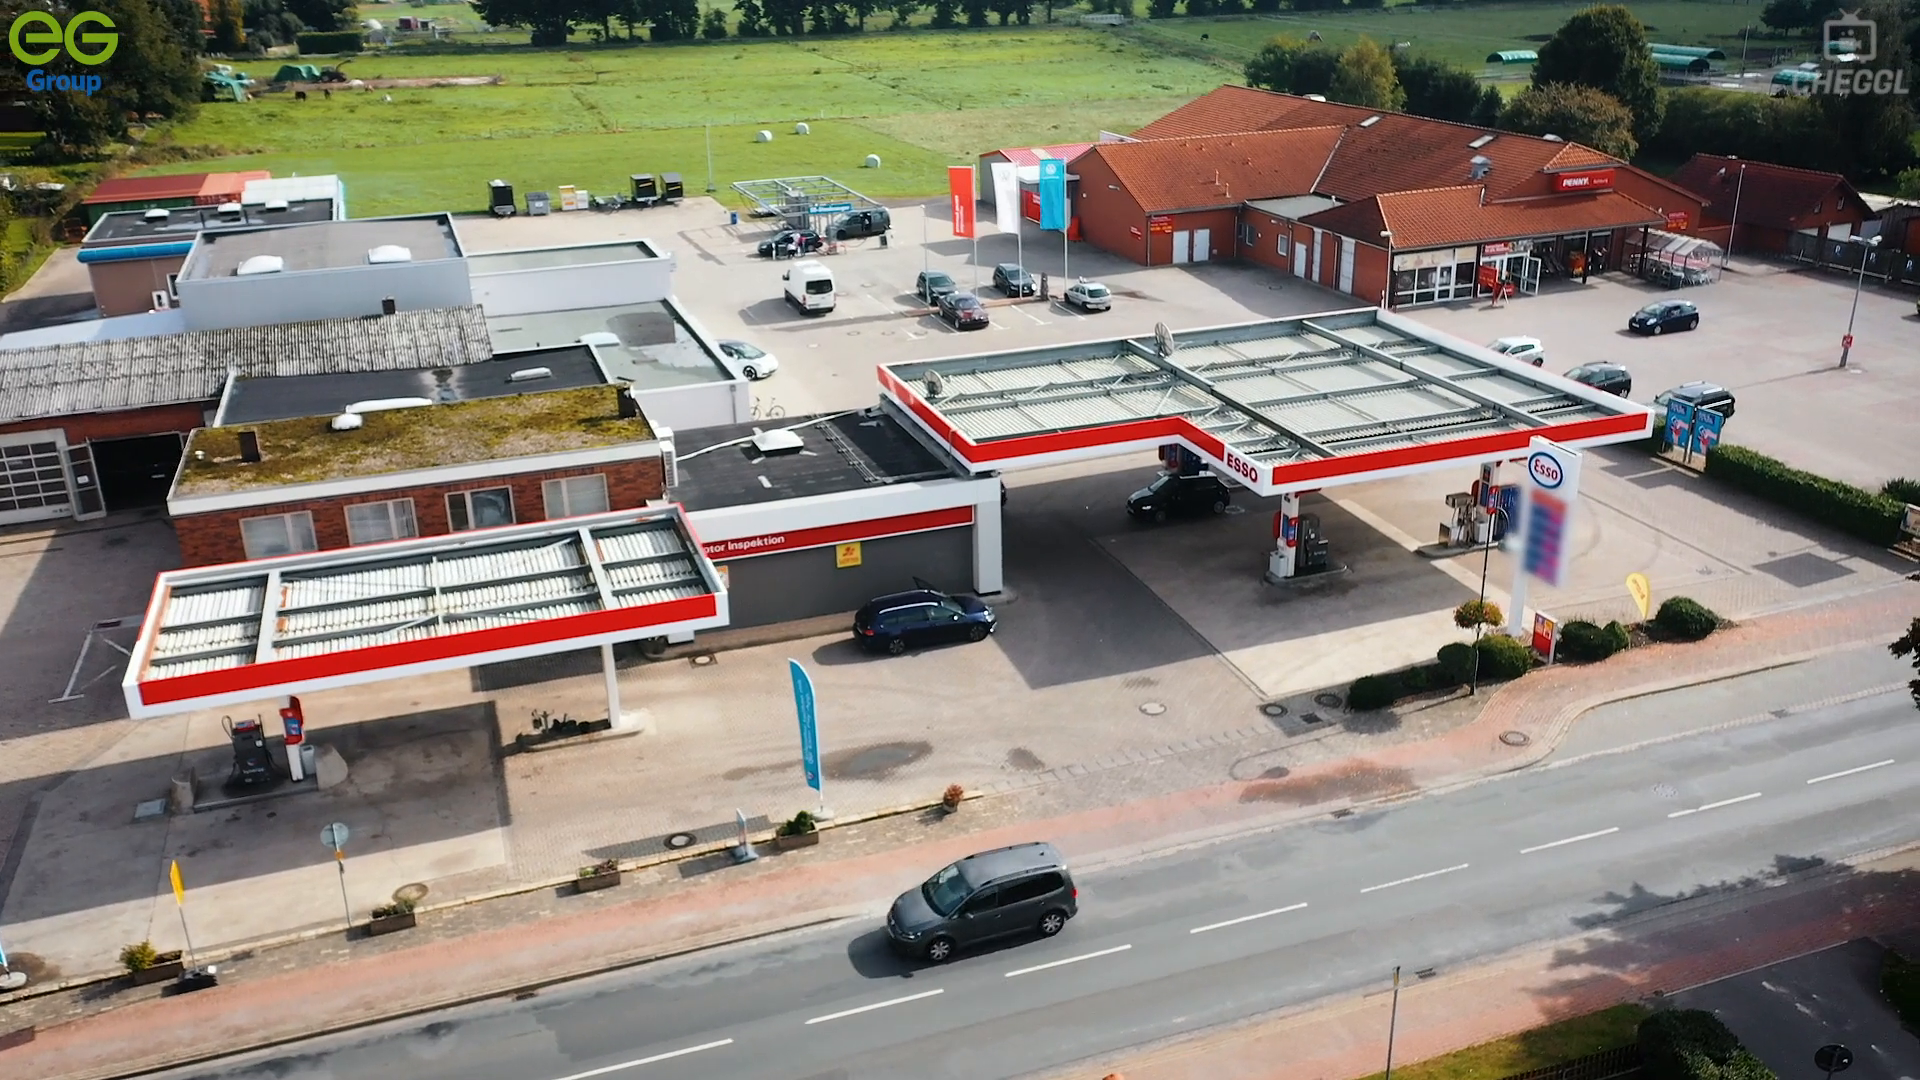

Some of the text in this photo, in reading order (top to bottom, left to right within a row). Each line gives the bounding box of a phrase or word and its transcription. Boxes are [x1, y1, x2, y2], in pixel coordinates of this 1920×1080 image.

[1227, 452, 1258, 483] ESSO
[703, 535, 786, 554] otor Inspektion
